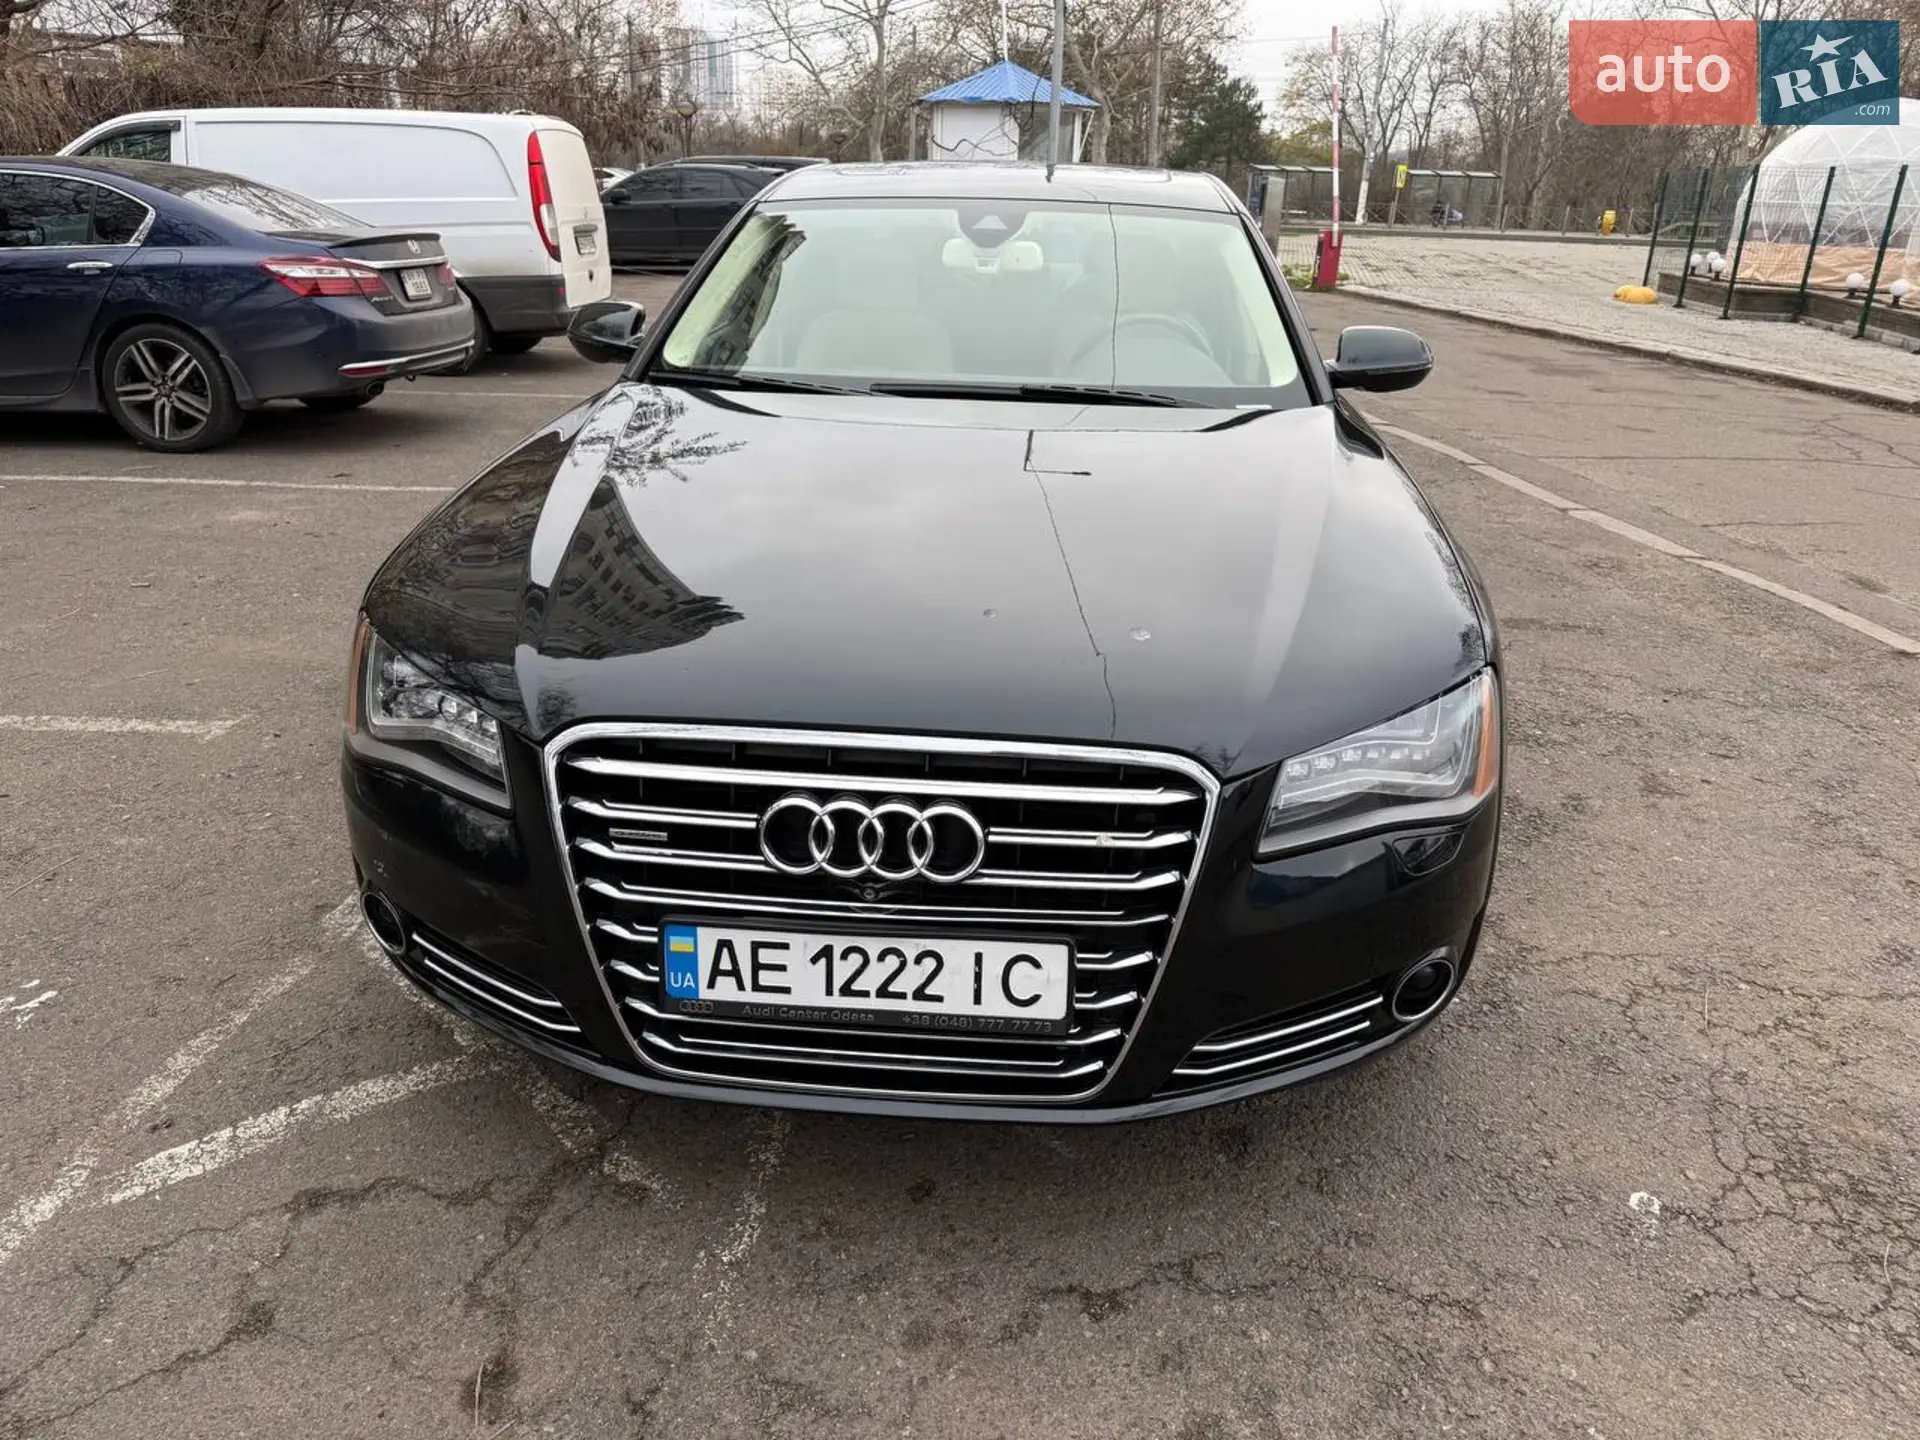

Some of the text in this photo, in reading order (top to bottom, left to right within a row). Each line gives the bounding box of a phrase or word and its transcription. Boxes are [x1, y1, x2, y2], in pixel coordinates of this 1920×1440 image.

[670, 972, 696, 988] UA
[706, 939, 1043, 1008] AE 1222 IC
[742, 1005, 775, 1017] Audi
[902, 1014, 930, 1026] +38
[934, 1015, 973, 1030] (048)
